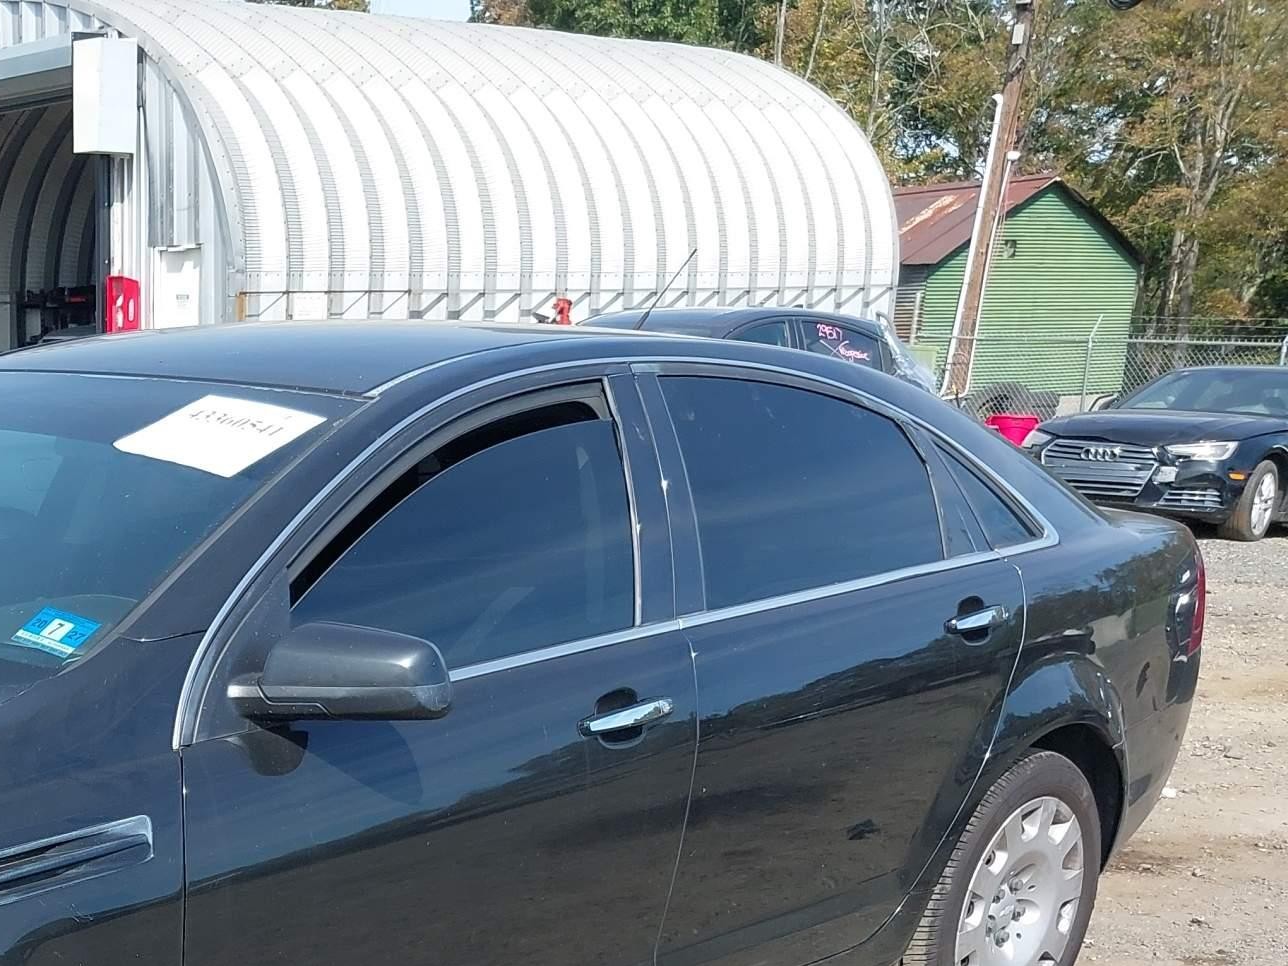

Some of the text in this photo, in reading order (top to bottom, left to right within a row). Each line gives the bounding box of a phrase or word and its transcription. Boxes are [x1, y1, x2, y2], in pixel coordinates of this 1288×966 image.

[31, 617, 87, 641] 20 7 27
